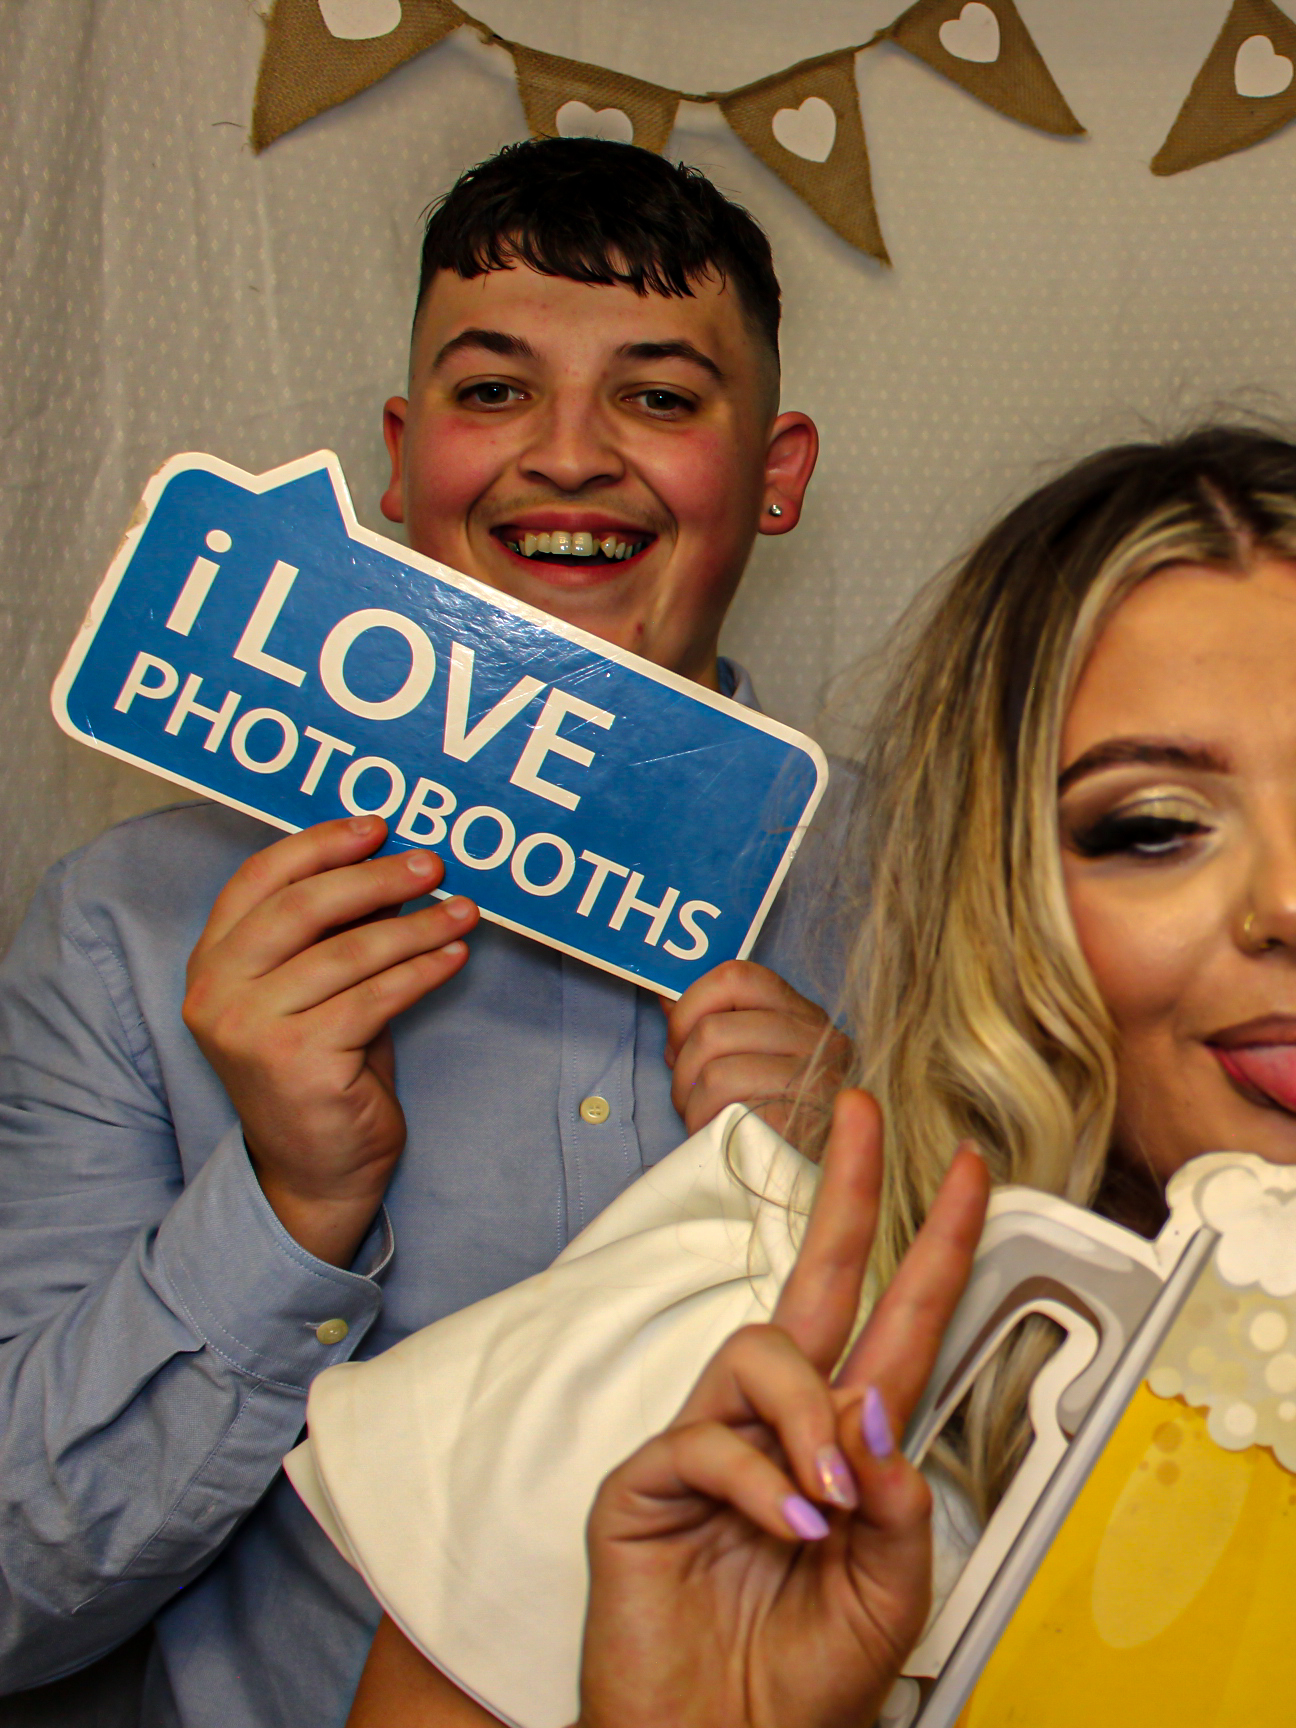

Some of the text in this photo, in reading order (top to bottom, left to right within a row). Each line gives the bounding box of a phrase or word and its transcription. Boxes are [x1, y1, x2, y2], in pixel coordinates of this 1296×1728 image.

[115, 652, 722, 962] PHOTOBOOTHS
[166, 529, 615, 811] i LOVE
